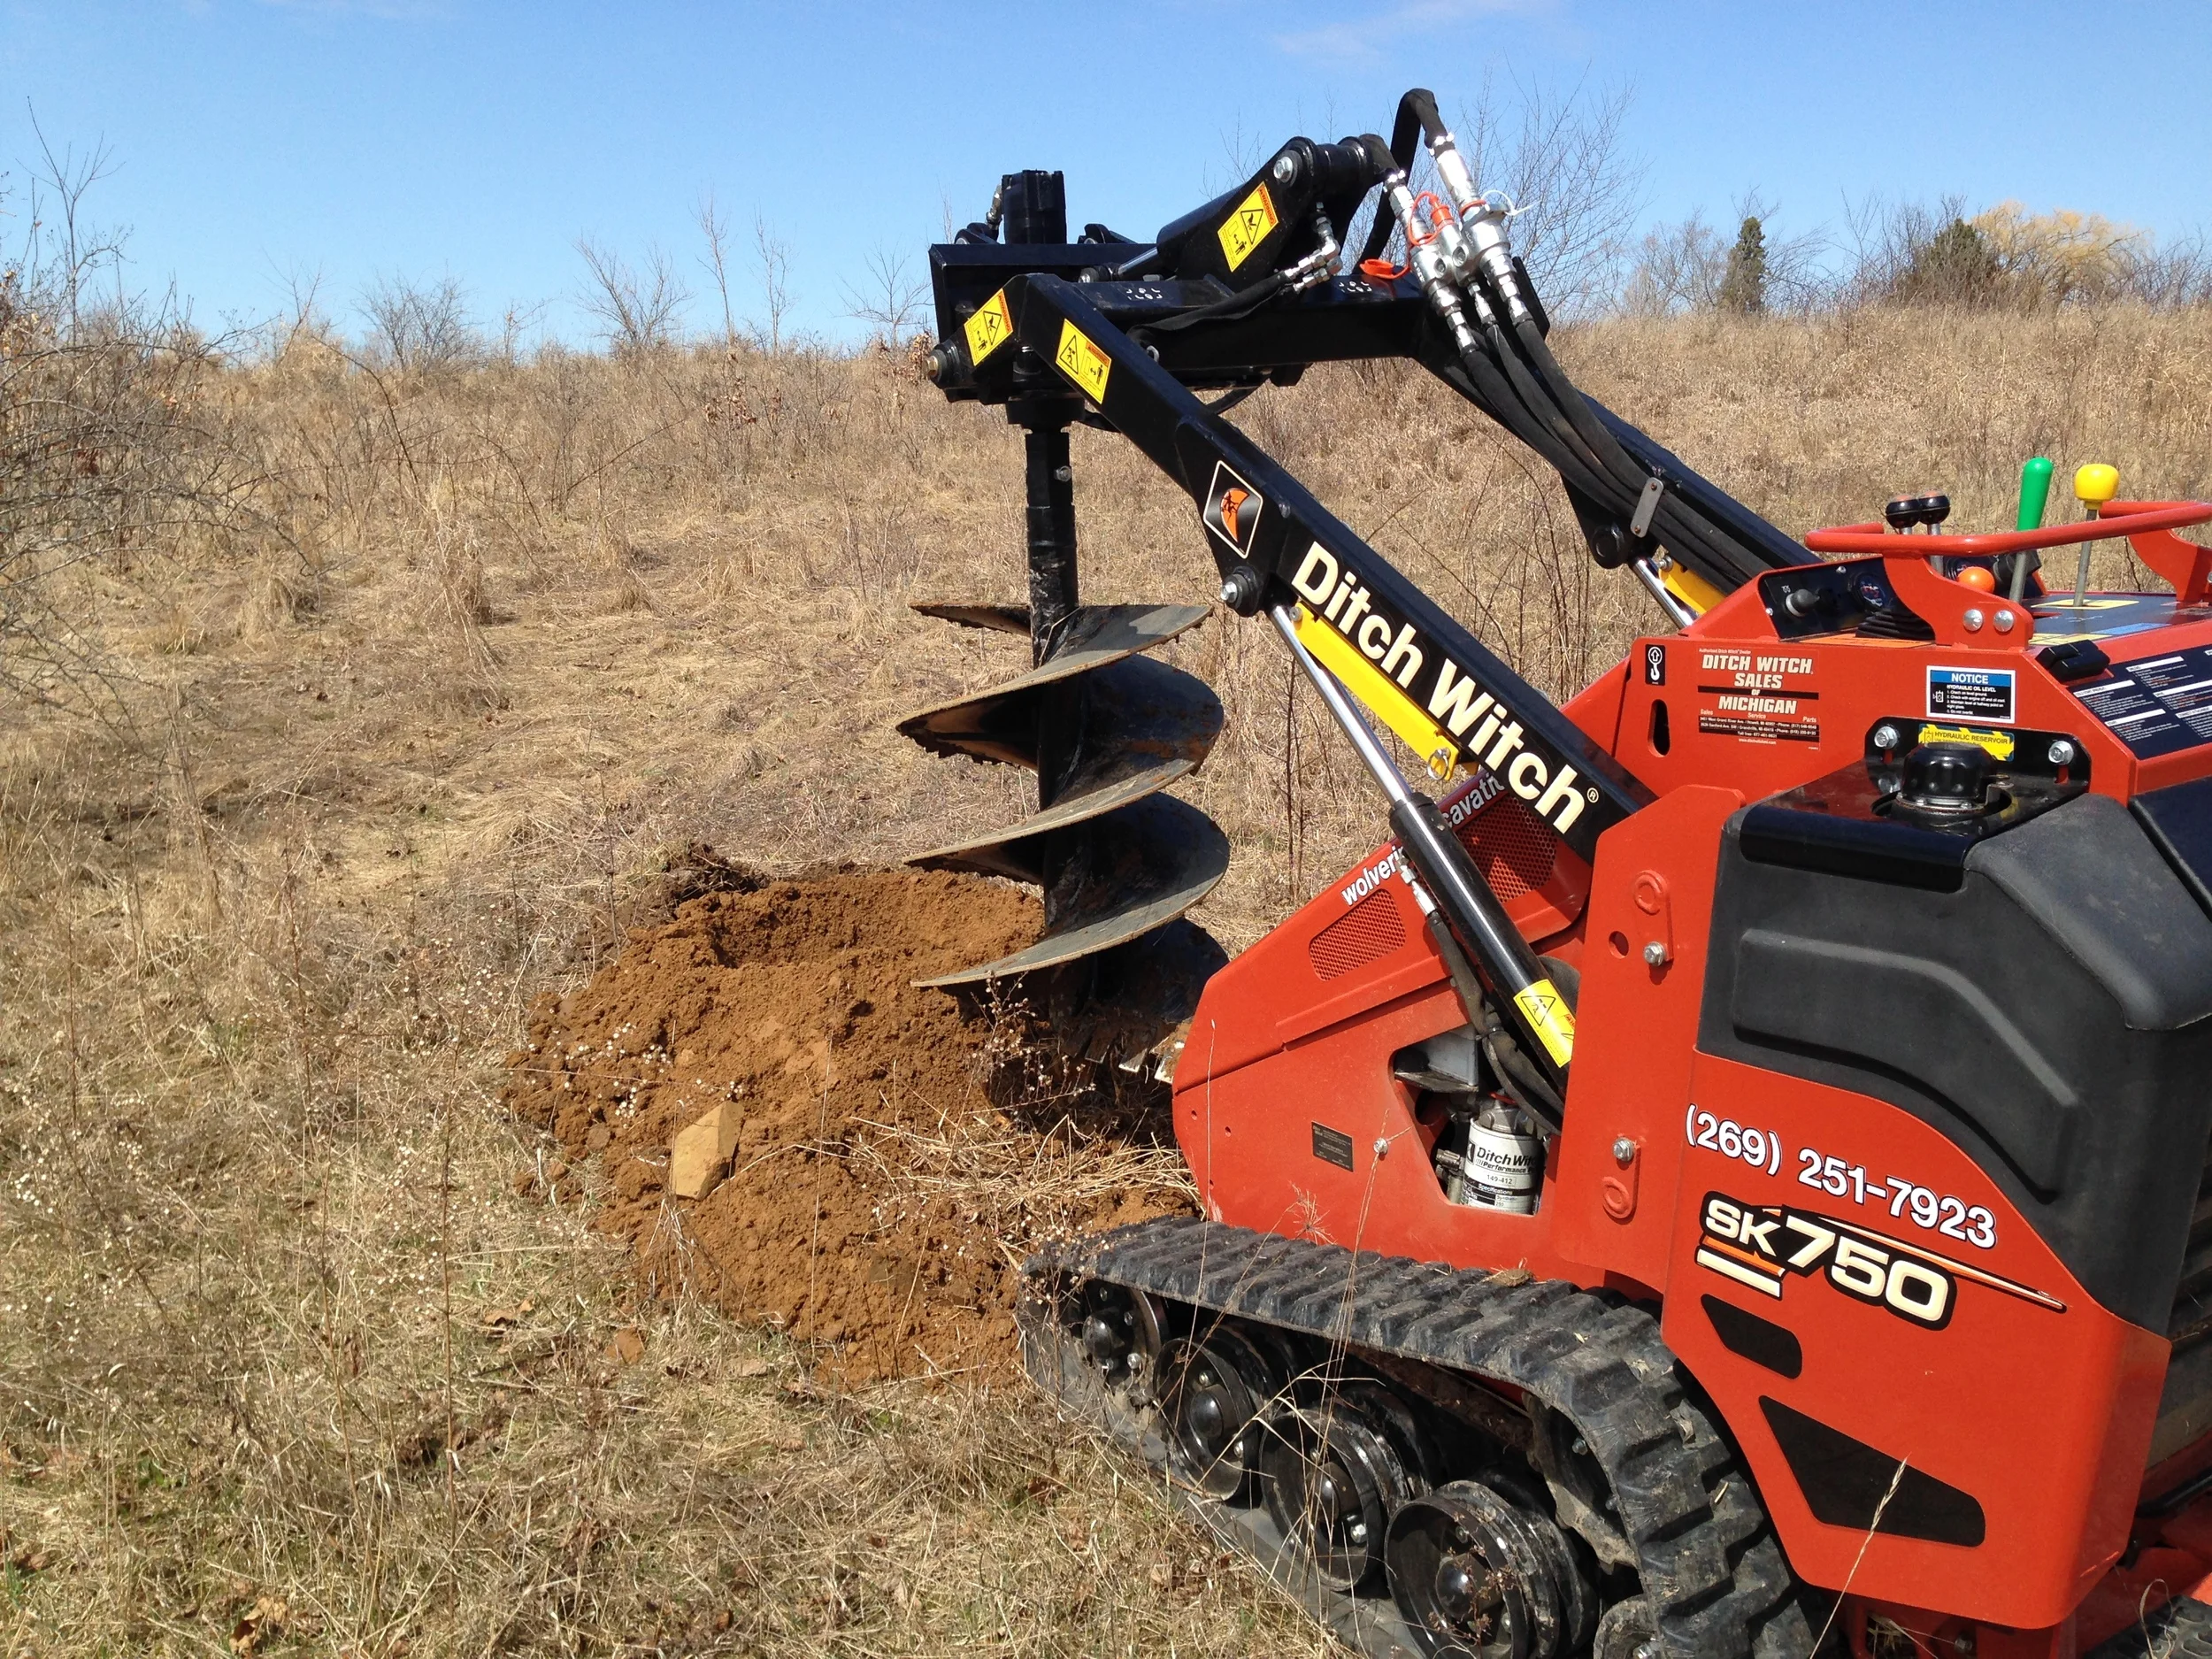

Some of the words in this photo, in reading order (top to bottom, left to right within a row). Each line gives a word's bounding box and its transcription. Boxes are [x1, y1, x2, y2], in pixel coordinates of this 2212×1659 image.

[1291, 541, 1425, 689] Ditch
[1701, 654, 1751, 671] DITCH
[1734, 672, 1783, 688] SALES
[1951, 672, 1989, 684] NOTICE
[1718, 695, 1797, 714] MICHIGAN
[1934, 731, 1970, 741] HYDRAULIC
[1971, 735, 2008, 744] RESERVOIR
[1476, 1146, 1511, 1166] Ditch
[1482, 1161, 1526, 1173] Performance
[1486, 1174, 1513, 1185] 149-412
[1686, 1103, 1783, 1176] (269)
[1797, 1147, 1997, 1250] 251-7923
[1478, 1183, 1513, 1194] Specifications
